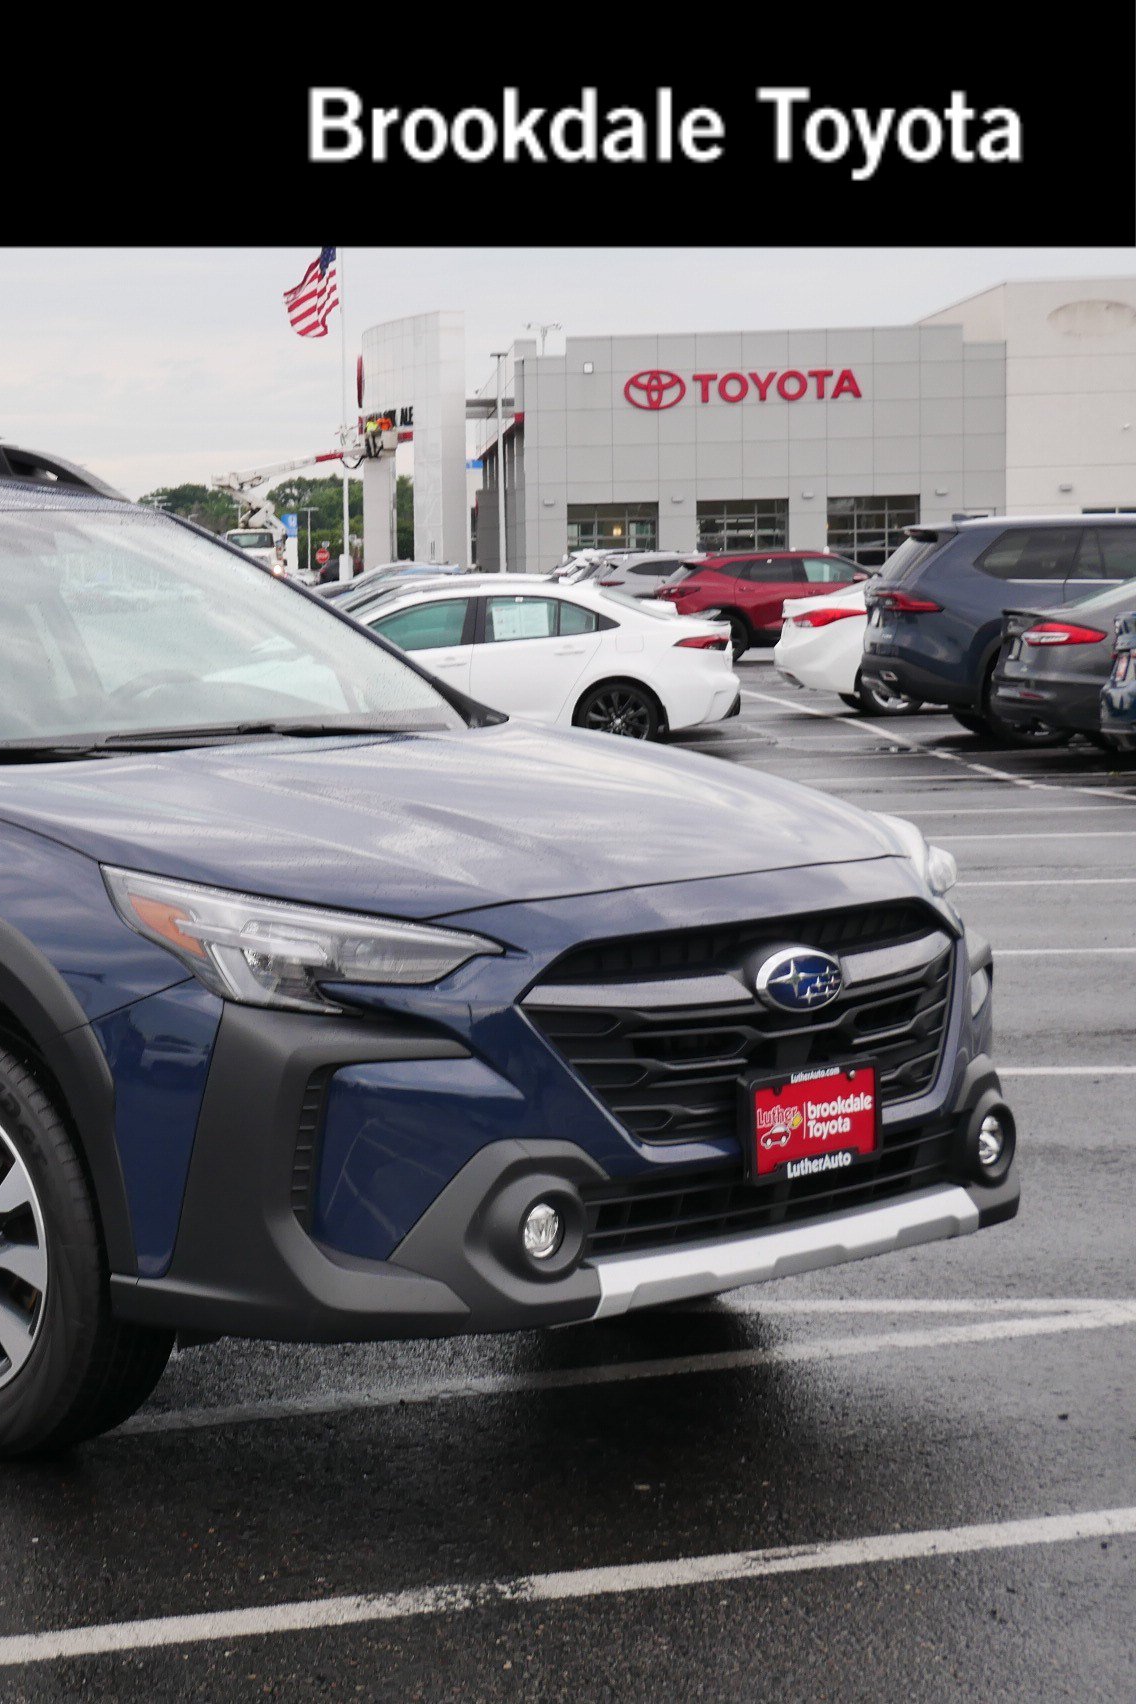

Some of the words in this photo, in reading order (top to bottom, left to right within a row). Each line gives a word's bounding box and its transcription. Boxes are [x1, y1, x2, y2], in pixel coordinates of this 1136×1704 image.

[692, 369, 862, 403] TOYOTA
[790, 1066, 840, 1084] LutherAuto.com
[756, 1104, 799, 1129] Luther
[807, 1092, 873, 1120] brookdale
[807, 1117, 851, 1140] Toyota
[786, 1151, 852, 1179] LutherAuto
